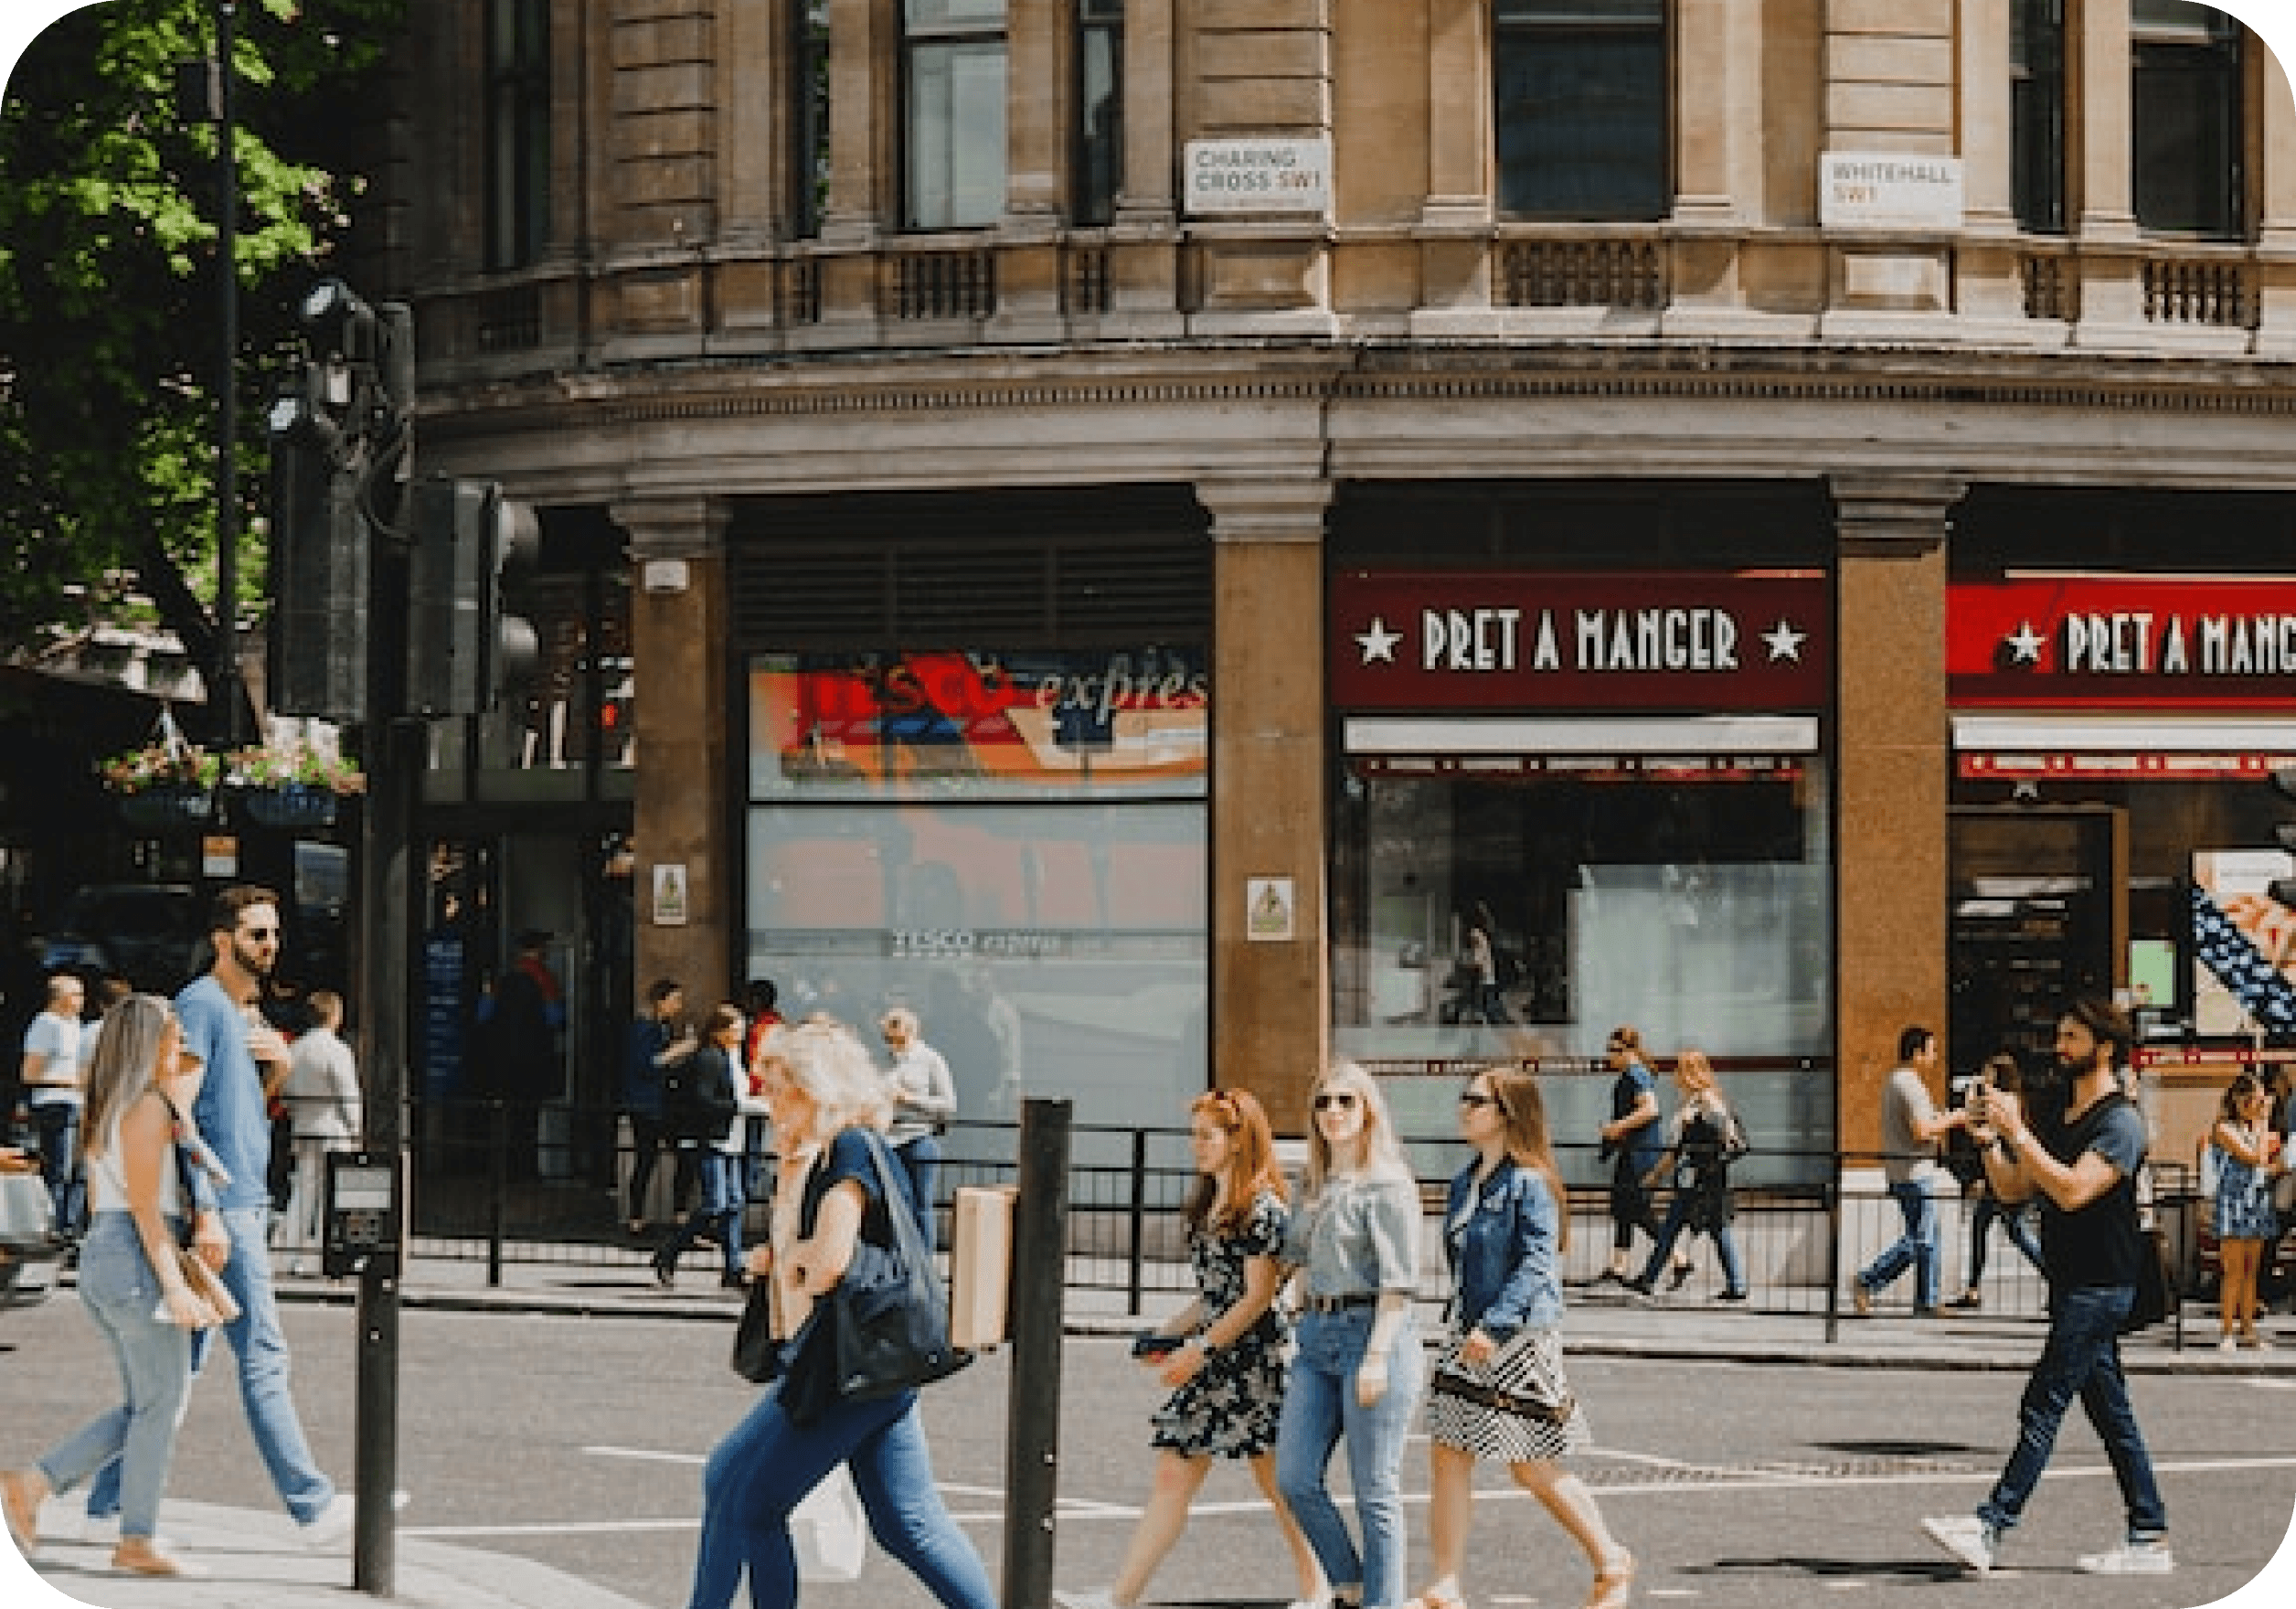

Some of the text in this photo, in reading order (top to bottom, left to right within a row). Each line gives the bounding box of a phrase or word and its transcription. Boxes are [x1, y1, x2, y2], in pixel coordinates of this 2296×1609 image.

[1196, 148, 1296, 167] CHARING
[1196, 171, 1320, 191] CROSS SW1
[1834, 163, 1953, 184] WHITEHALL
[1834, 183, 1877, 203] SW1
[1422, 609, 1738, 670] PRET A MANGER
[2067, 613, 2153, 670] PRET
[2163, 613, 2189, 670] A
[892, 929, 973, 953] TESCO
